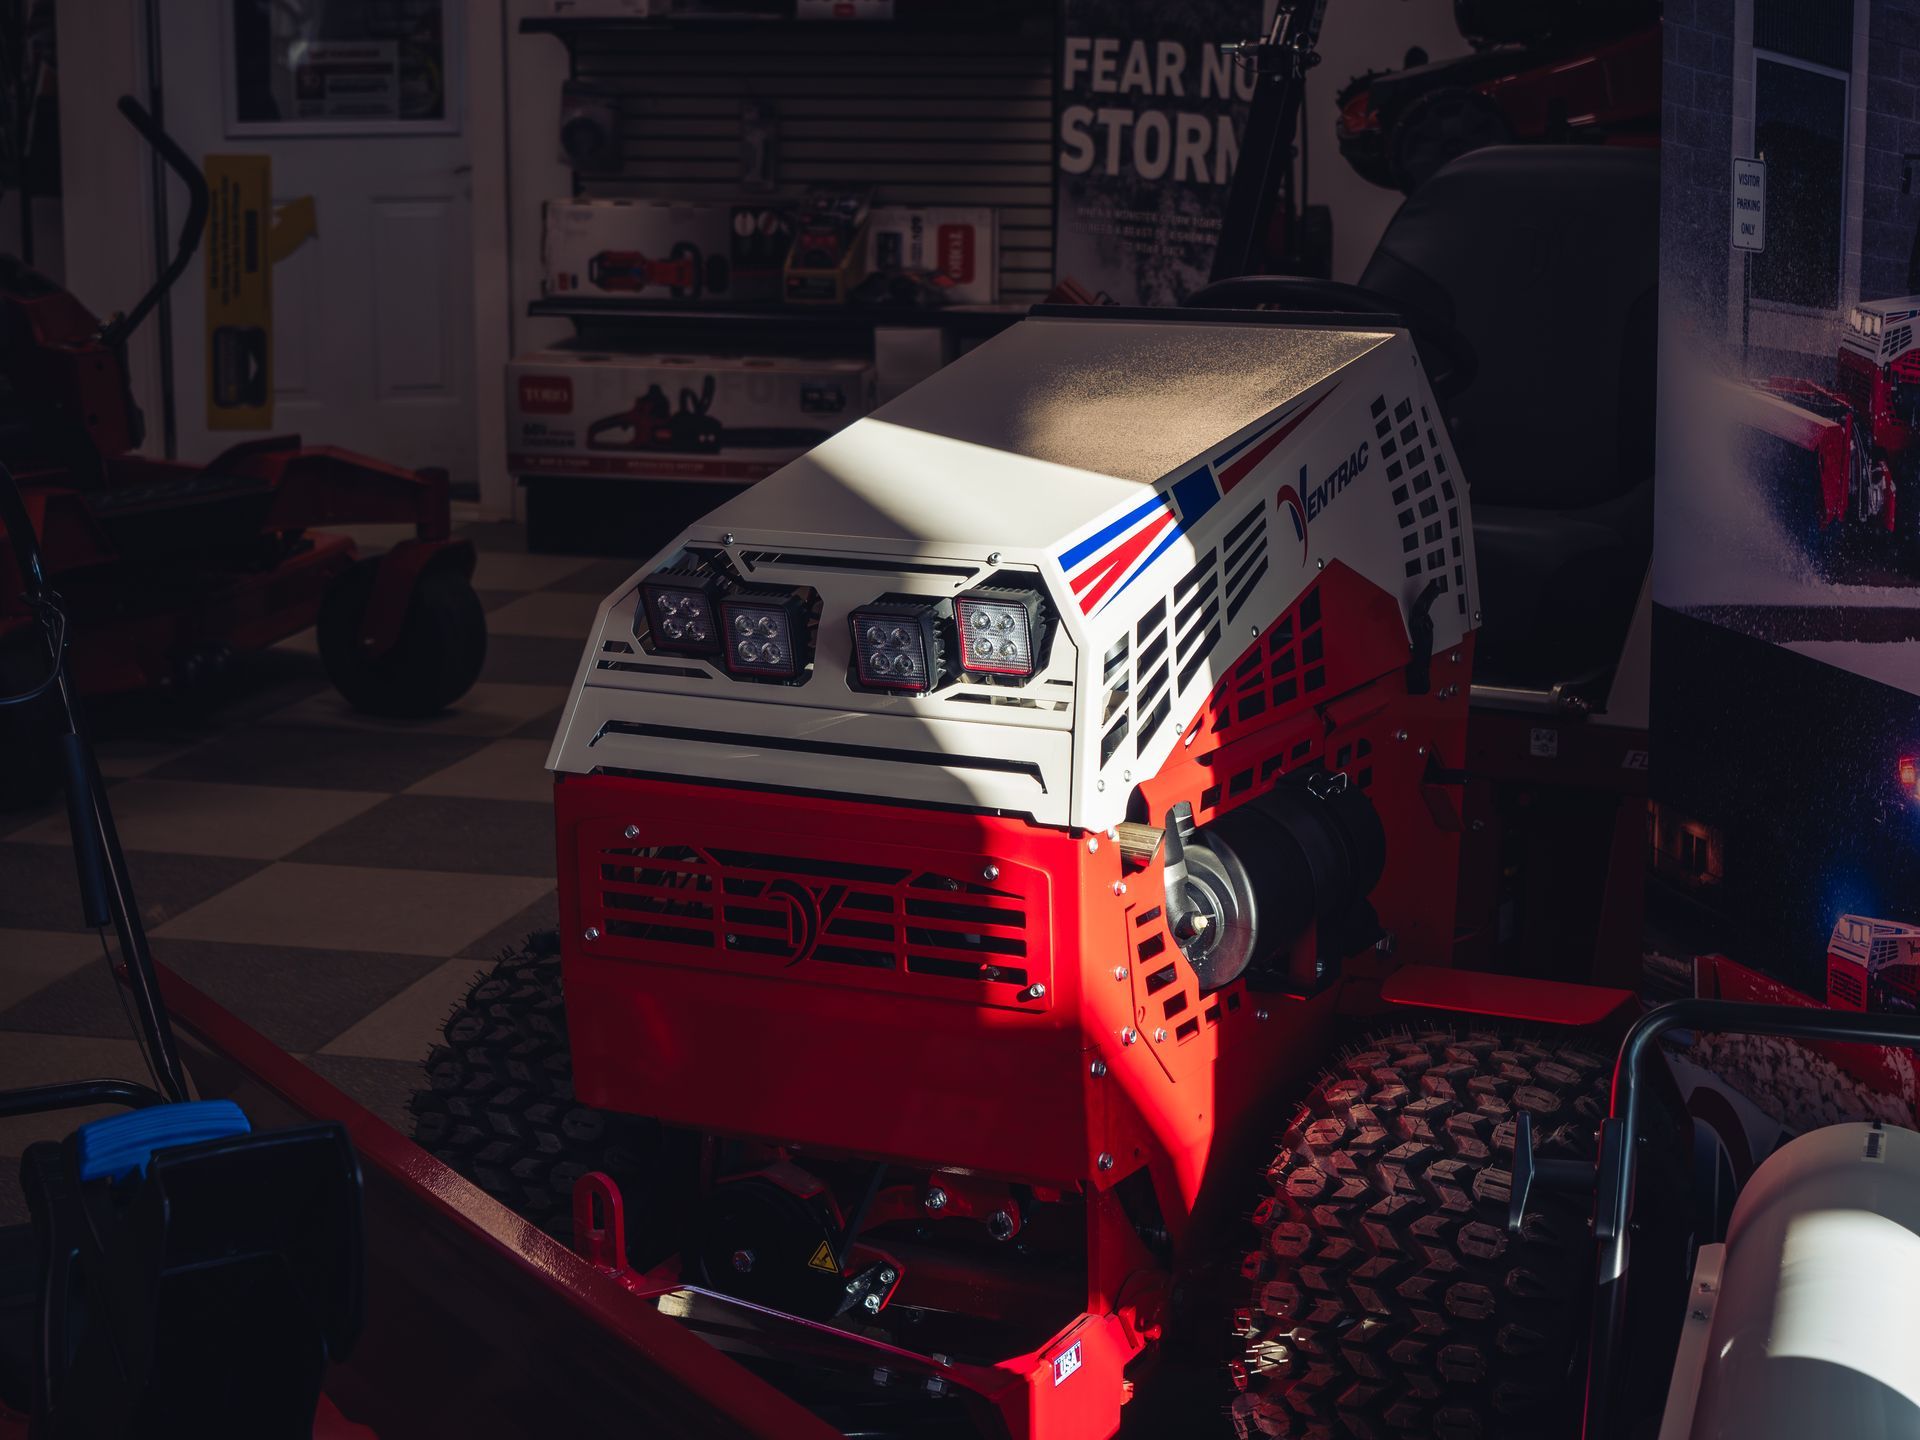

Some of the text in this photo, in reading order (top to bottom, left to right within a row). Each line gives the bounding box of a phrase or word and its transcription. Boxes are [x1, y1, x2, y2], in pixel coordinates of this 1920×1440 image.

[1063, 37, 1187, 97] FEAR
[1738, 173, 1760, 187] VISITOR
[1736, 197, 1760, 212] PARKING
[1741, 222, 1755, 235] ONLY
[948, 230, 965, 279] TORO
[524, 388, 569, 402] TORO
[1277, 441, 1369, 568] VENTRAC
